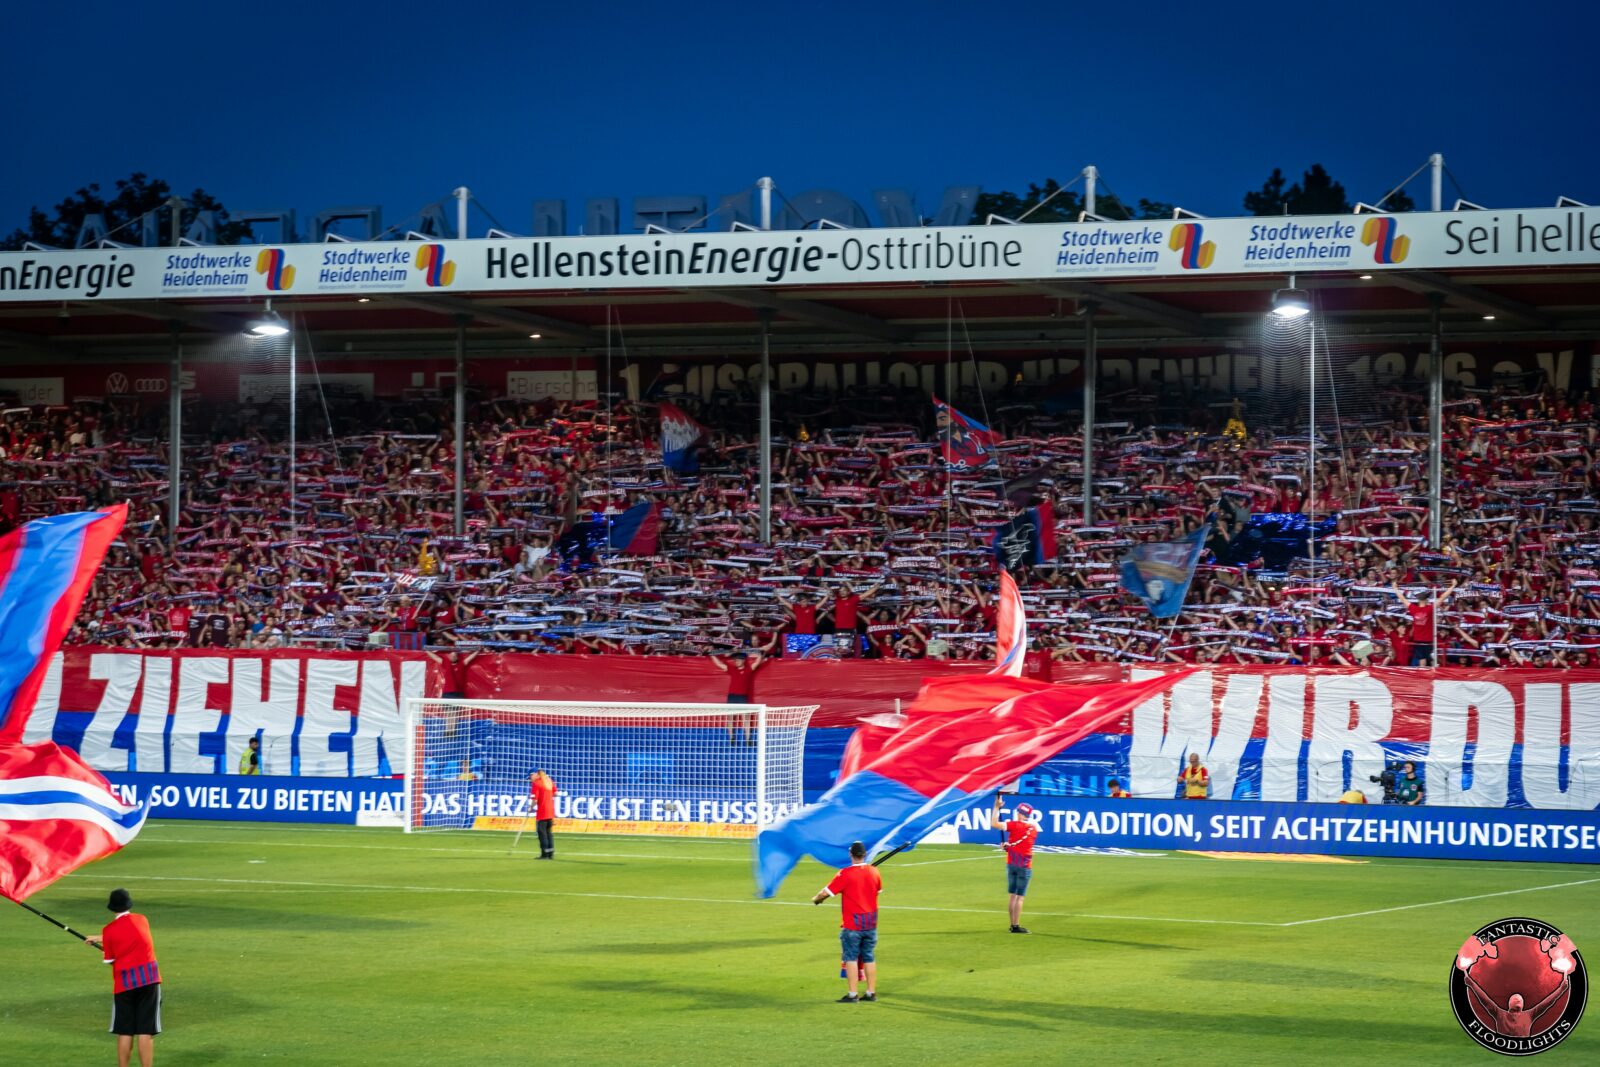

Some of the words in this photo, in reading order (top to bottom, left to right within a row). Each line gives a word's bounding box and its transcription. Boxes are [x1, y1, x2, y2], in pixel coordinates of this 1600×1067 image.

[1061, 227, 1163, 247] Stadtwerke
[1250, 220, 1356, 242] Stadtwerke
[1445, 217, 1500, 255] Sei
[166, 251, 252, 270] Stadtwerke
[321, 247, 411, 266] Stadtwerke
[1056, 248, 1160, 266] Heidenheim
[1244, 242, 1352, 260] Heidenheim
[0, 255, 136, 297] nEnergie
[162, 270, 249, 287] Heidenheim
[318, 265, 408, 284] Heidenheim
[79, 652, 426, 778] ZIEHEN
[1131, 667, 1393, 803] WIR
[150, 785, 180, 808] SO
[186, 786, 232, 809] VIEL
[237, 787, 268, 810] ZU
[274, 788, 353, 812] BIETEN
[420, 793, 461, 815] DAS
[467, 791, 603, 819] HERZSÜCK
[610, 796, 645, 821] IST
[651, 798, 691, 823] EIN
[1050, 810, 1202, 842] TRADITION,
[1209, 814, 1266, 840] SEIT
